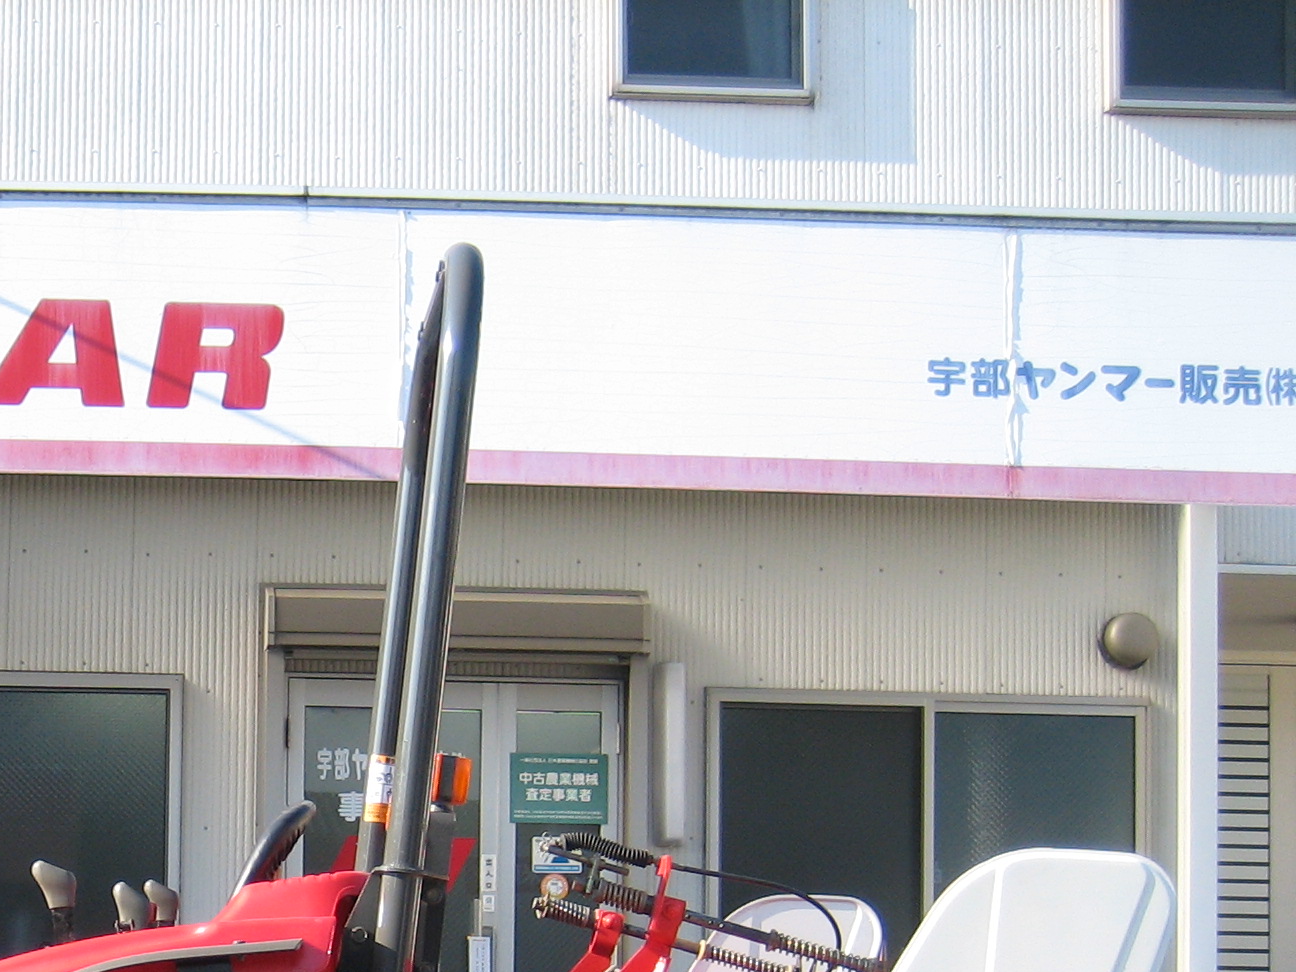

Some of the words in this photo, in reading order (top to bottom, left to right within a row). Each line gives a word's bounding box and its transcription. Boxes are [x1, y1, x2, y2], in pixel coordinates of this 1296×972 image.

[519, 772, 599, 786] 中古農業機械
[526, 787, 592, 802] 査定事業者
